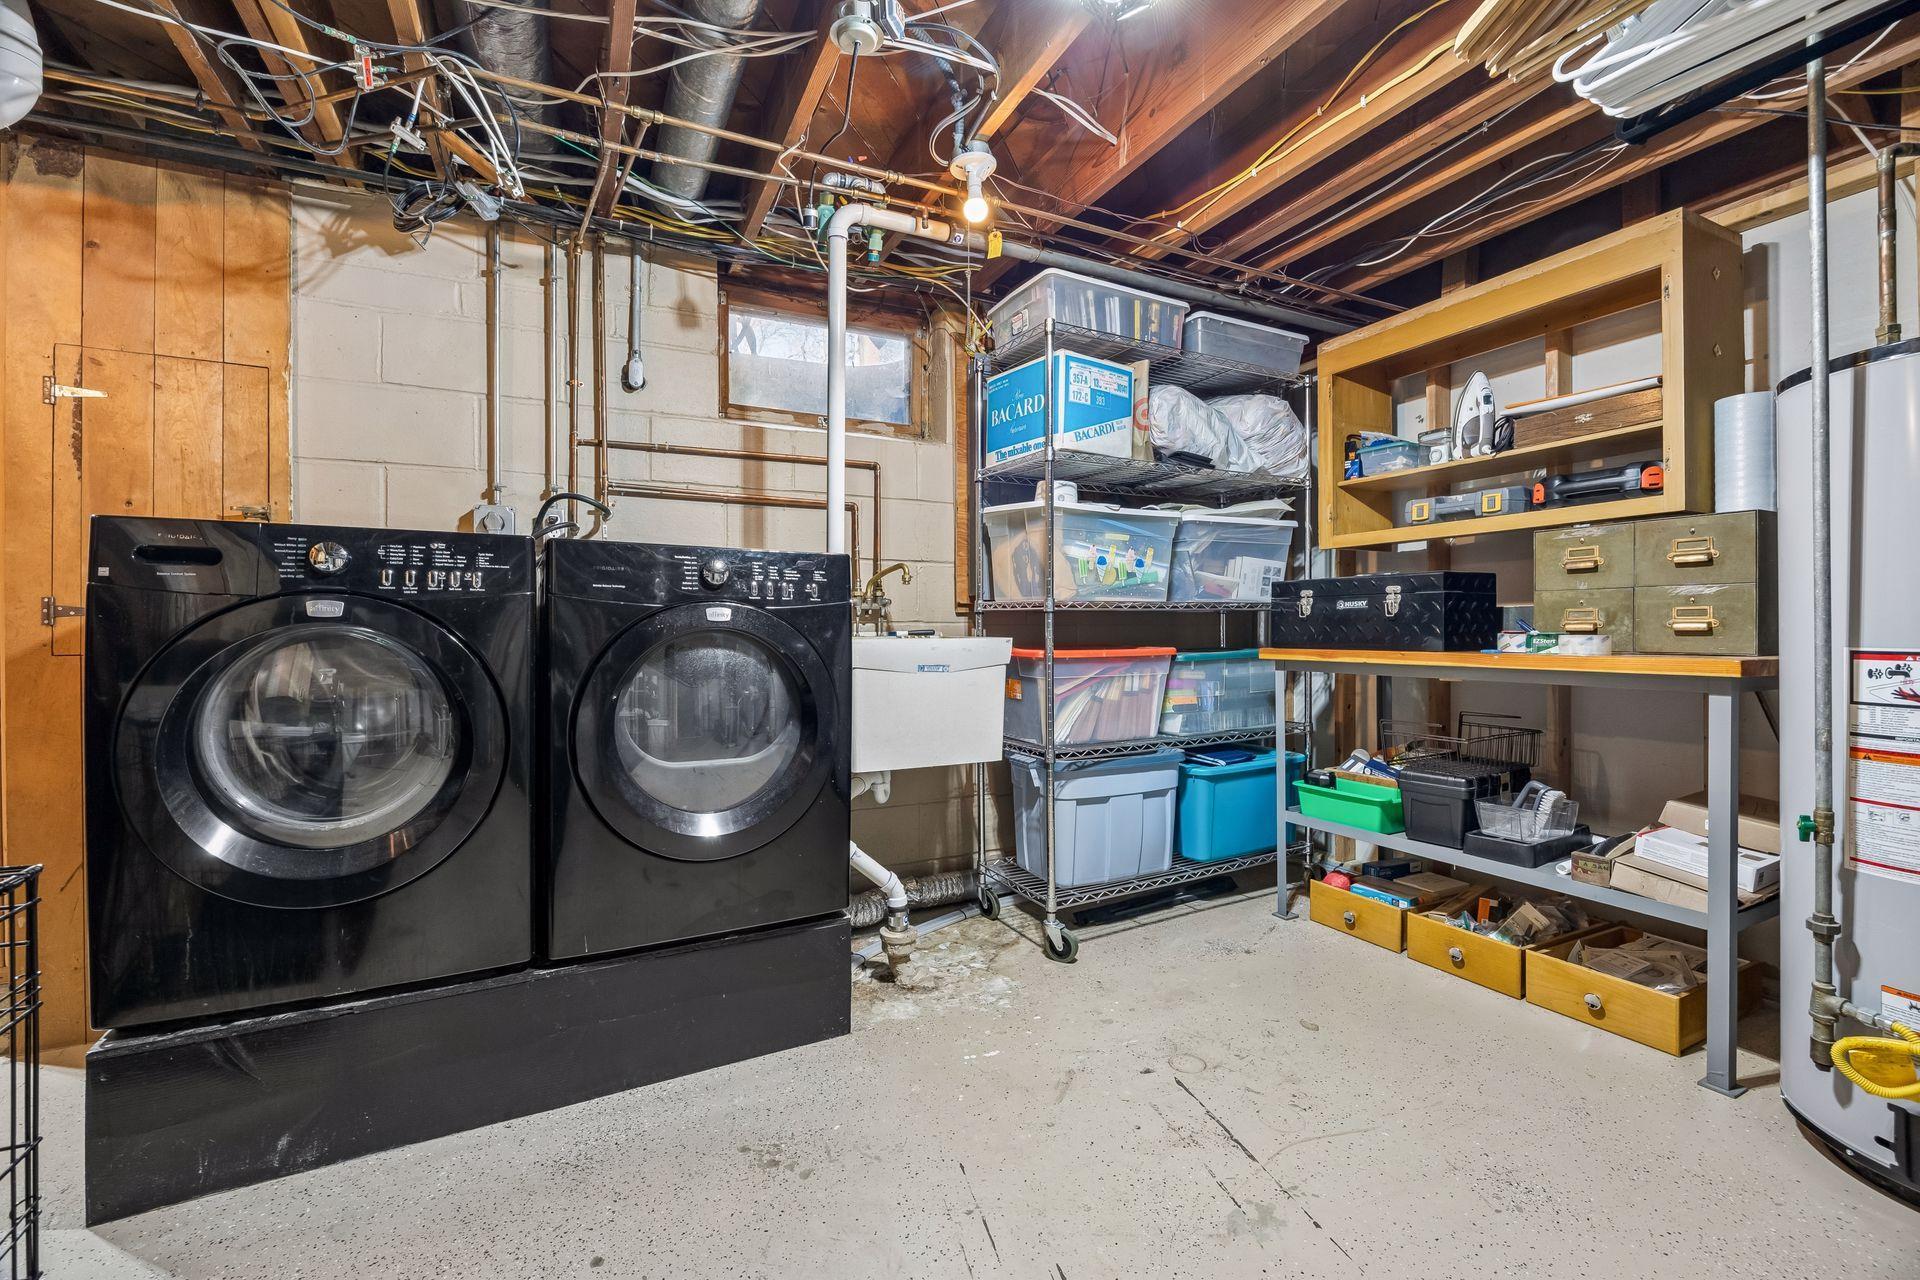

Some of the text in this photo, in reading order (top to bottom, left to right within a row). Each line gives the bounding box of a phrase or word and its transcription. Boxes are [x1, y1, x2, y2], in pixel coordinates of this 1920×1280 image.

[991, 393, 1045, 428] BACARD
[1074, 421, 1116, 442] BACARDI
[994, 450, 1008, 462] The
